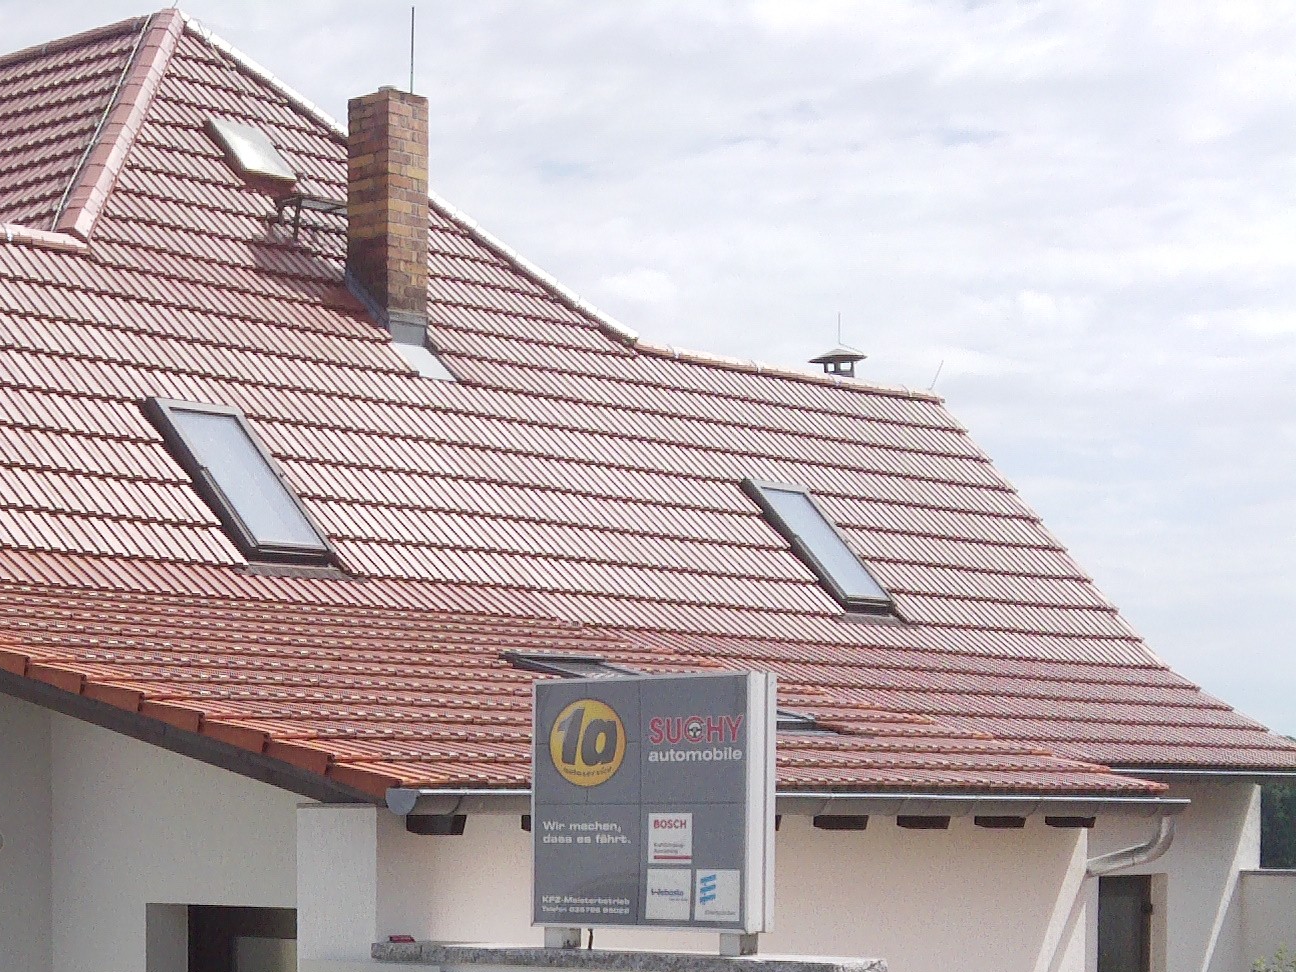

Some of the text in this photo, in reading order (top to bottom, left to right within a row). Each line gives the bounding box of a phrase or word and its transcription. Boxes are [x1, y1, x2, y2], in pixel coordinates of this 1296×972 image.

[558, 707, 617, 766] 1a
[649, 713, 744, 744] SUCHY
[648, 746, 742, 762] automobile
[543, 820, 565, 831] Wir
[653, 819, 687, 829] BOSCH
